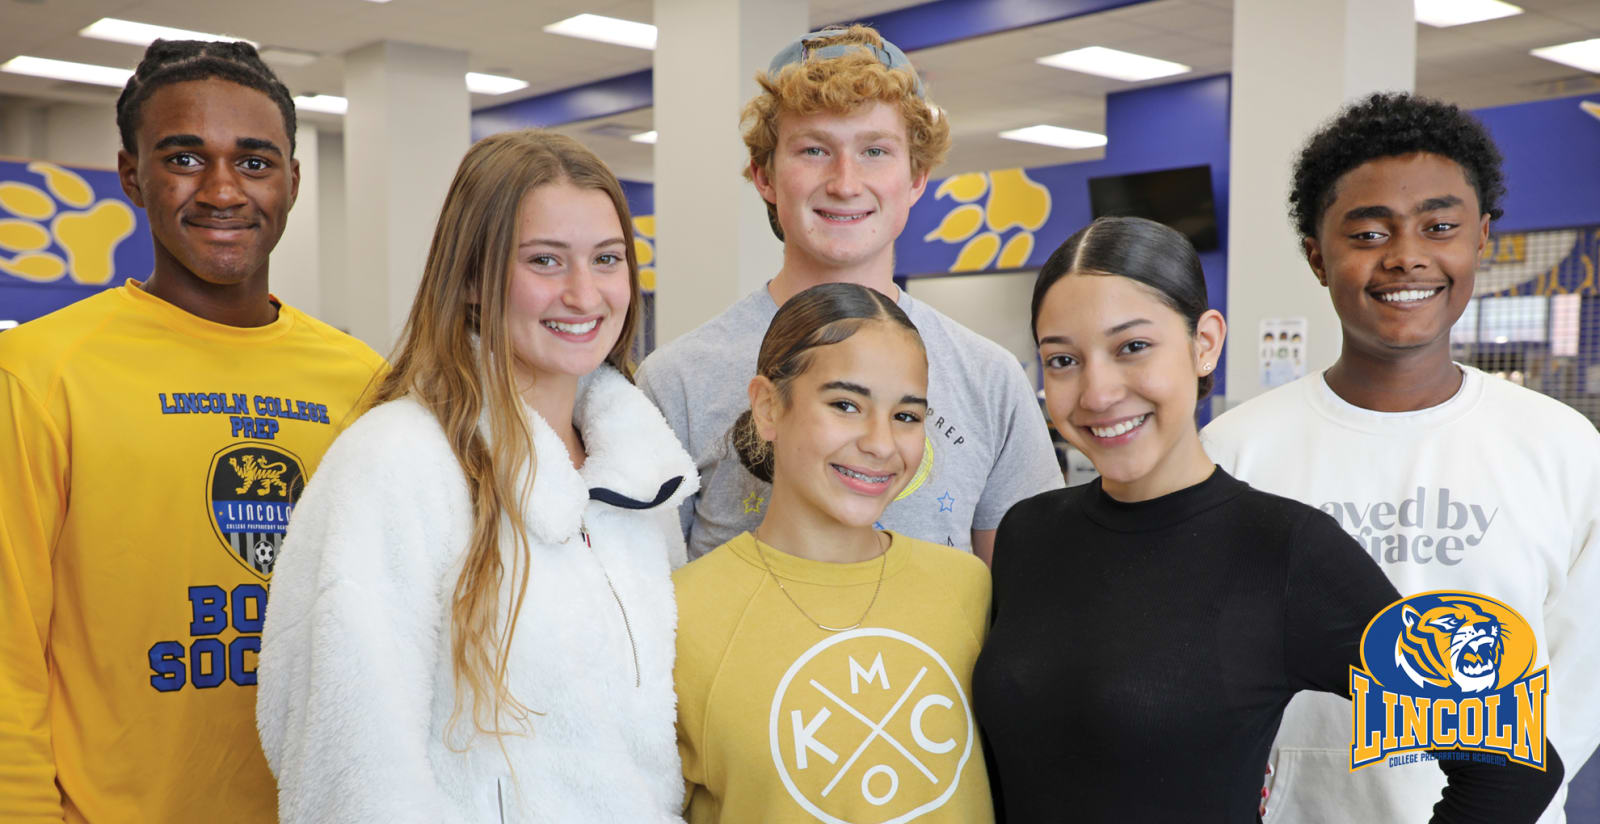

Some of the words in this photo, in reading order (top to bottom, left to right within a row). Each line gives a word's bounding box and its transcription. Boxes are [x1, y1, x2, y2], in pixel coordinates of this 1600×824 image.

[159, 393, 249, 414] LINCOLN
[253, 395, 330, 424] COLLEGE
[230, 416, 279, 440] PREP
[926, 407, 965, 449] PREP
[1318, 486, 1426, 531] aved
[1437, 487, 1499, 547] by
[188, 583, 271, 636] BO
